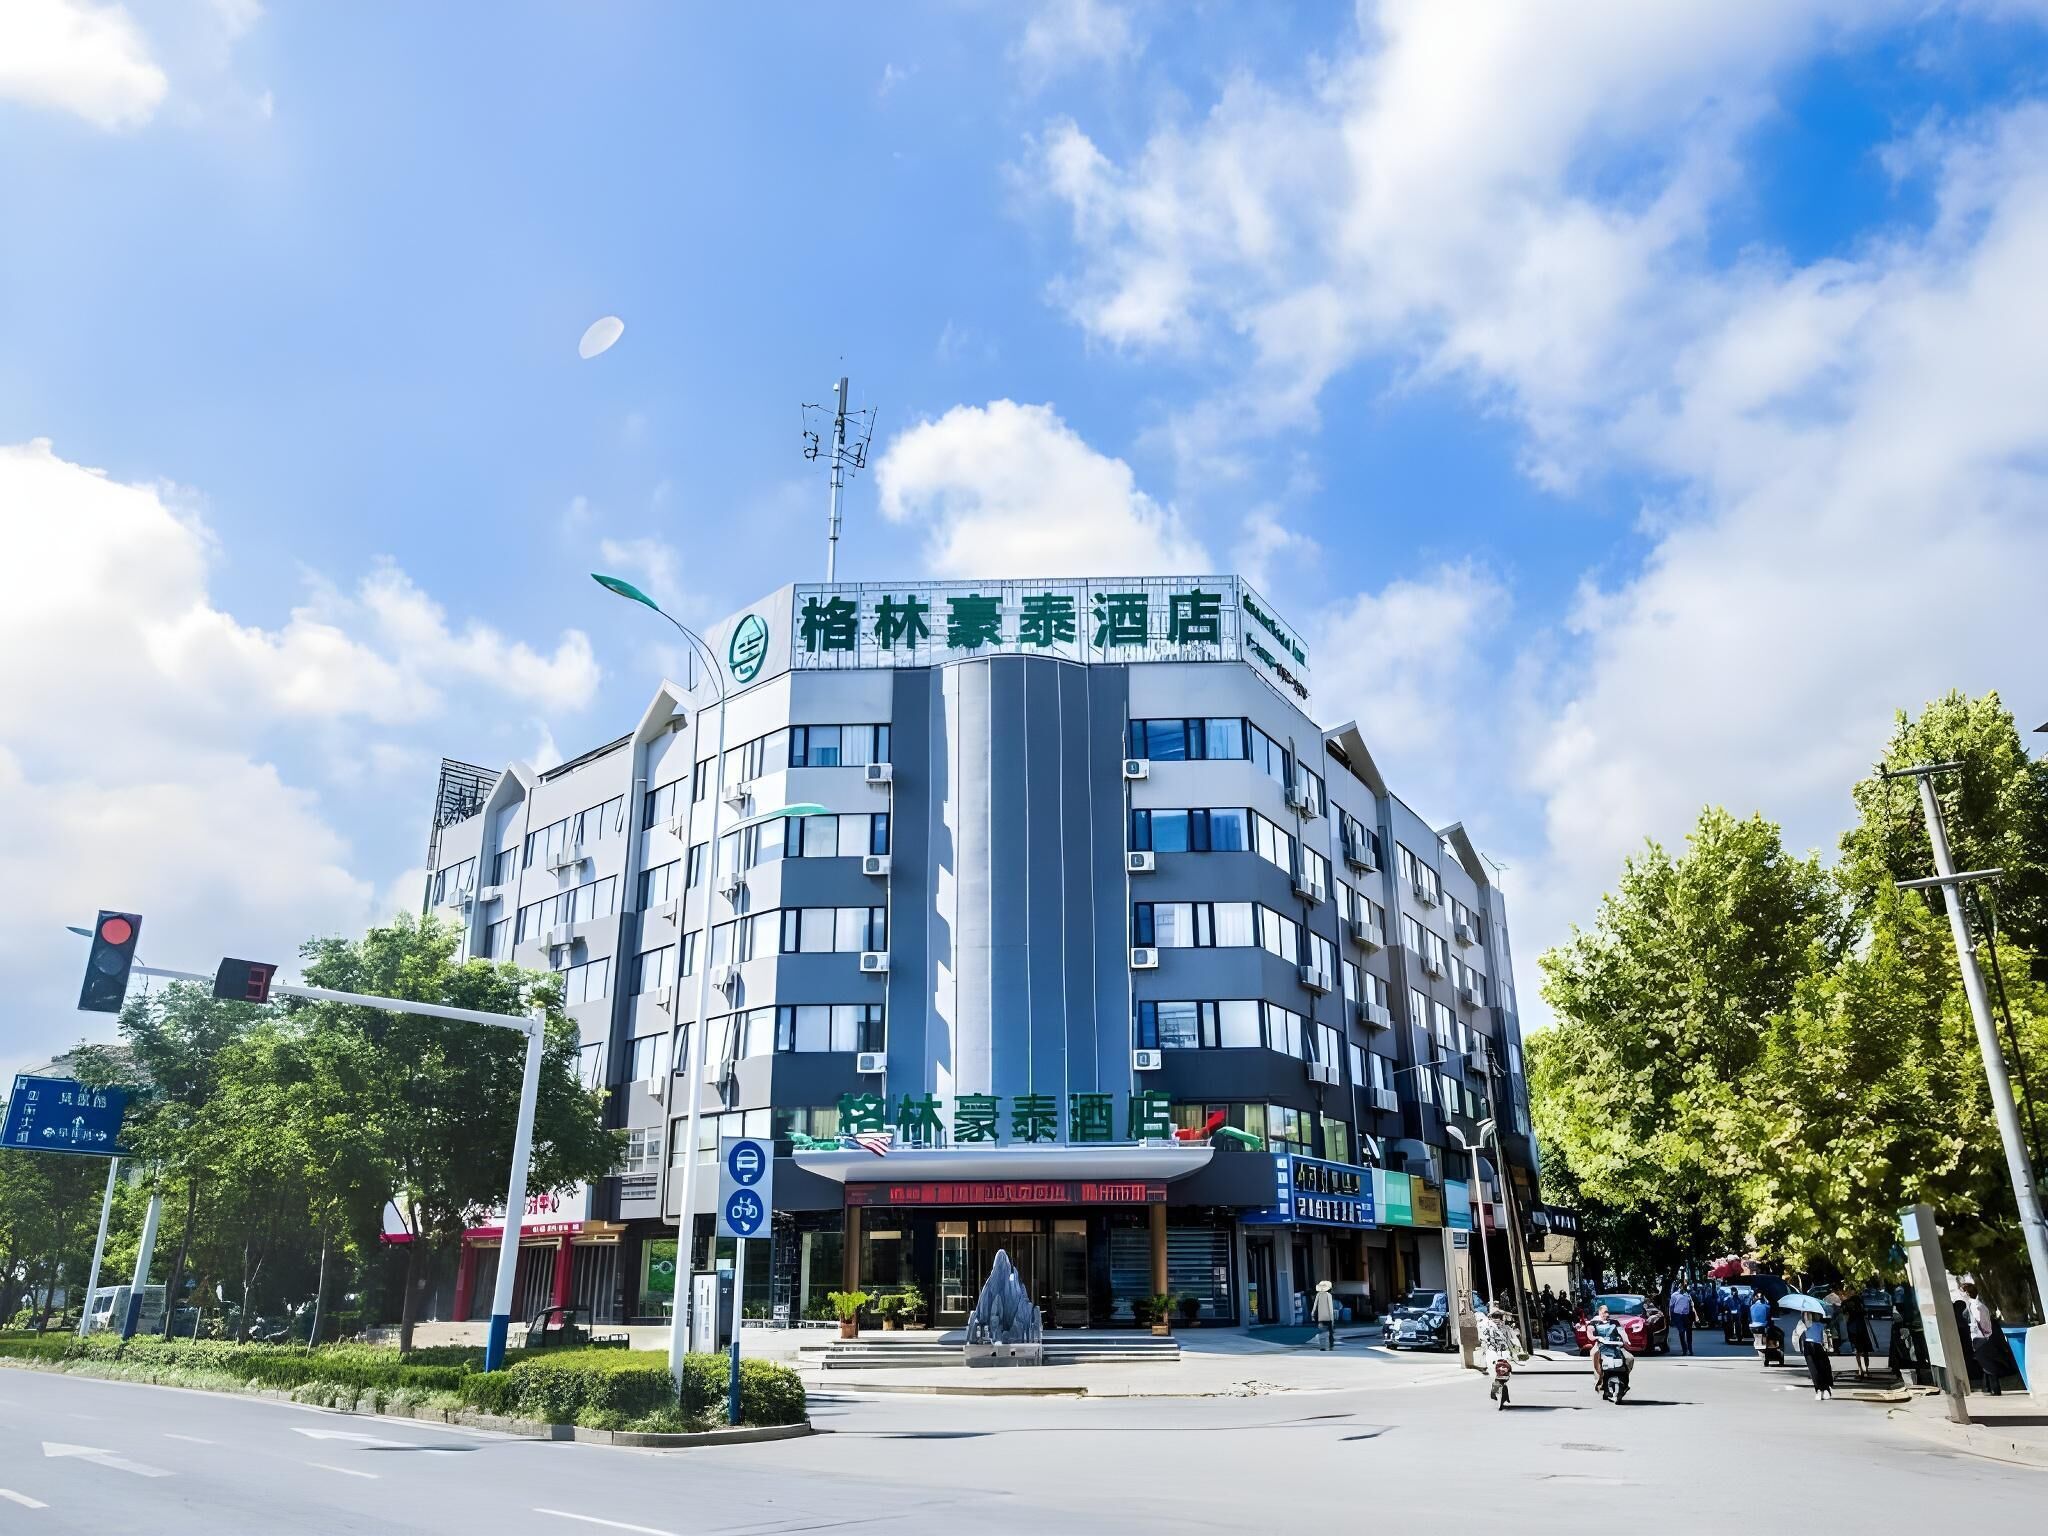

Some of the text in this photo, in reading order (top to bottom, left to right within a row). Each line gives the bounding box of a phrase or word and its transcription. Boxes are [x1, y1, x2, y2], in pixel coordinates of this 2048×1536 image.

[801, 588, 1222, 653] 格林豪泰酒店
[838, 1089, 1171, 1143] 格林豪泰酒店
